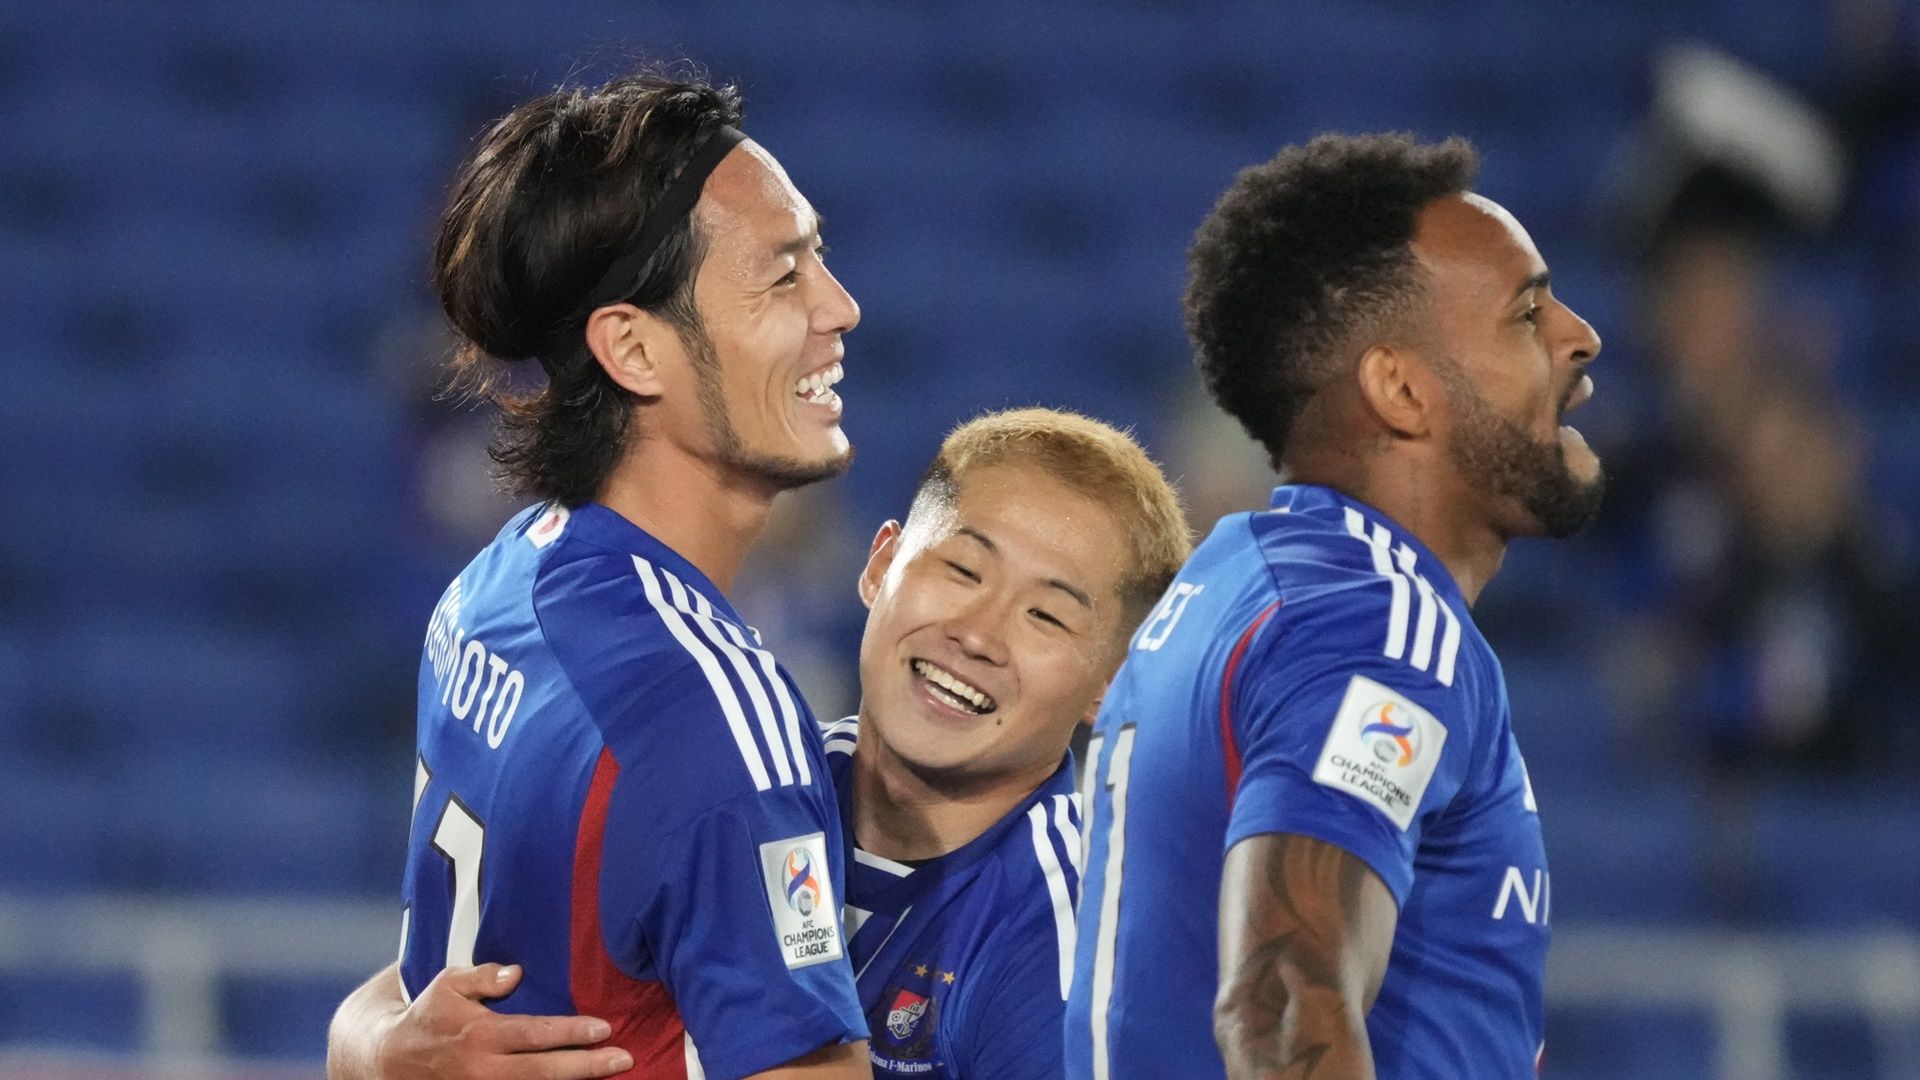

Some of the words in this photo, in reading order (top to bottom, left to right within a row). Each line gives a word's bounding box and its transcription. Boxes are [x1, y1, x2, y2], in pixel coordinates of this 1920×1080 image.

[1330, 754, 1412, 807] CHAMPIONS
[1342, 771, 1395, 808] LEAGUE
[802, 920, 815, 929] AFC
[783, 926, 836, 947] CHAMPIONS
[794, 941, 829, 959] LEAGUE
